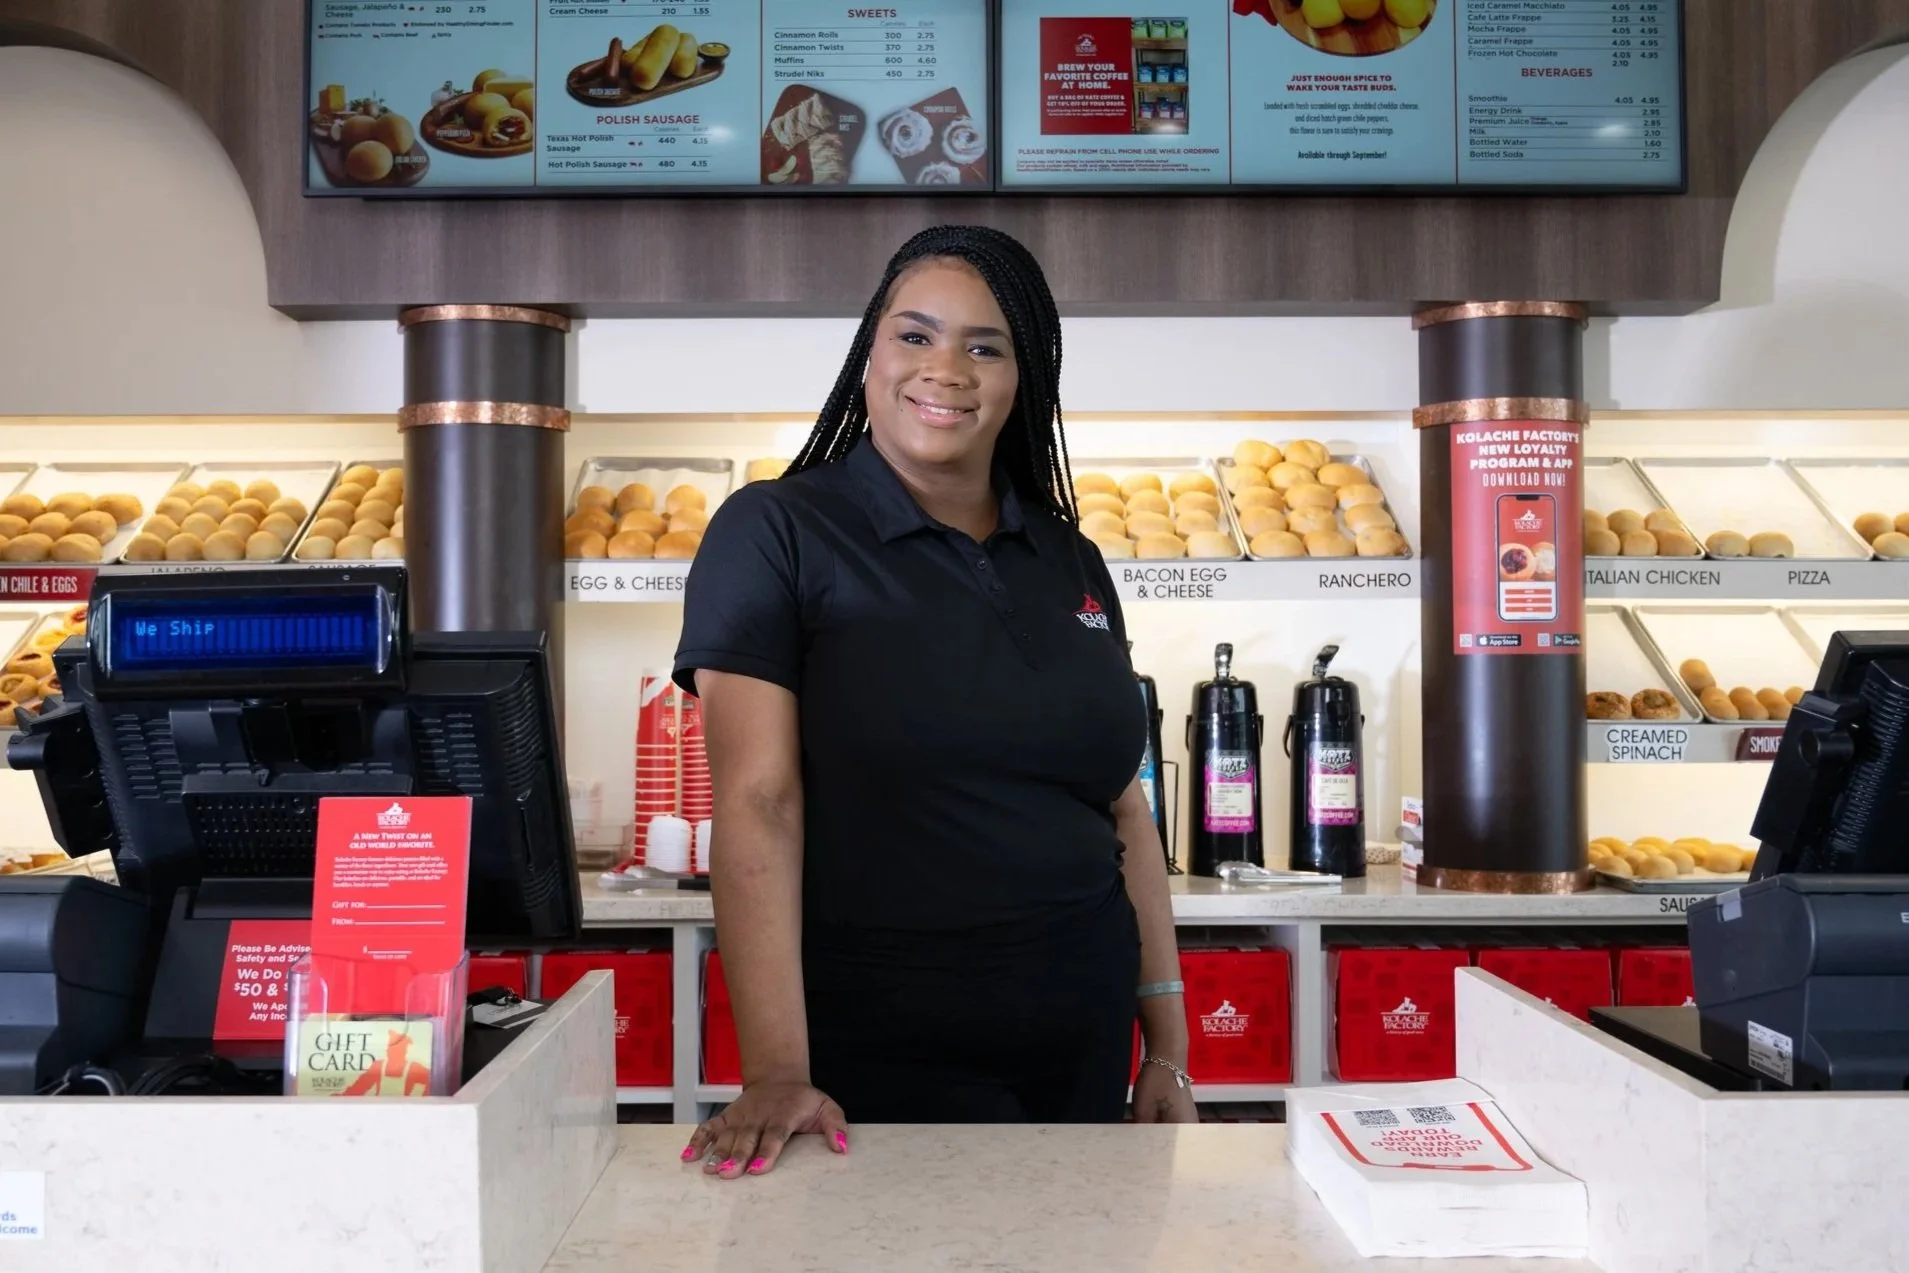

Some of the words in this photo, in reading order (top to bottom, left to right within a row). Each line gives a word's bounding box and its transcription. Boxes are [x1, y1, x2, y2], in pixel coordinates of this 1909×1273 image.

[1523, 2, 1566, 10] Macchiato
[549, 7, 577, 15] Cream
[578, 7, 608, 15] Cheese
[847, 9, 897, 18] SWEETS
[1512, 14, 1542, 22] Frappe
[1496, 25, 1527, 33] Frappe
[774, 31, 816, 39] Cinnamon
[1504, 37, 1534, 45] Frappe
[1057, 63, 1085, 71] BREW
[1087, 63, 1115, 71] YOUR
[774, 70, 805, 78] Strudel
[1521, 68, 1593, 77] BEVERAGES
[1061, 81, 1074, 89] AT
[1078, 81, 1111, 89] HOME.
[1469, 107, 1498, 115] Energy
[597, 115, 640, 125] POLISH
[643, 115, 700, 125] SAUSAGE
[547, 145, 581, 153] Sausage
[1298, 151, 1325, 159] Available
[1326, 151, 1351, 160] through
[1352, 151, 1387, 160] September!
[548, 161, 563, 169] Hot
[565, 161, 591, 169] Polish
[592, 161, 627, 169] Sausage
[658, 160, 676, 168] 480
[1456, 431, 1520, 444] KOLACHE
[1523, 430, 1579, 443] FACTORY'S
[1479, 444, 1511, 455] NEW
[1514, 444, 1567, 455] LOYALTY
[1470, 457, 1540, 469] PROGRAM
[1542, 458, 1552, 468] &
[1554, 458, 1574, 469] APP
[1483, 472, 1540, 487] DOWNLOAD
[1544, 472, 1566, 487] NOW!
[1124, 568, 1184, 582] BACON
[1190, 568, 1227, 582] EGG
[1646, 570, 1721, 585] CHICKEN
[1788, 571, 1831, 585] PIZZA
[11, 576, 39, 593] CHILE
[41, 576, 49, 593] &
[52, 576, 78, 593] EGGS
[571, 576, 608, 590] EGG
[614, 576, 626, 590] &
[1319, 573, 1412, 588] RANCHERO
[1137, 584, 1148, 598] &
[1154, 584, 1214, 598] CHEESE
[136, 620, 157, 636] We
[170, 620, 215, 636] Ship
[1489, 638, 1502, 646] App
[1502, 638, 1519, 646] Store
[1607, 729, 1688, 744] CREAMED
[1612, 746, 1682, 760] SPINACH
[231, 945, 262, 953] Please
[236, 954, 266, 964] Safety
[267, 954, 286, 962] and
[237, 968, 259, 980] We
[263, 968, 282, 980] Do
[234, 982, 262, 997] $50
[266, 983, 278, 997] &
[252, 1002, 268, 1010] We
[249, 1012, 268, 1022] Any
[1382, 1015, 1428, 1023] KOLACHE
[1203, 1024, 1244, 1032] FACTORY
[315, 1033, 372, 1051] GIFT
[308, 1053, 376, 1071] CARD
[1381, 1128, 1451, 1136] TODAY!
[1370, 1139, 1483, 1147] DOWNLOAD
